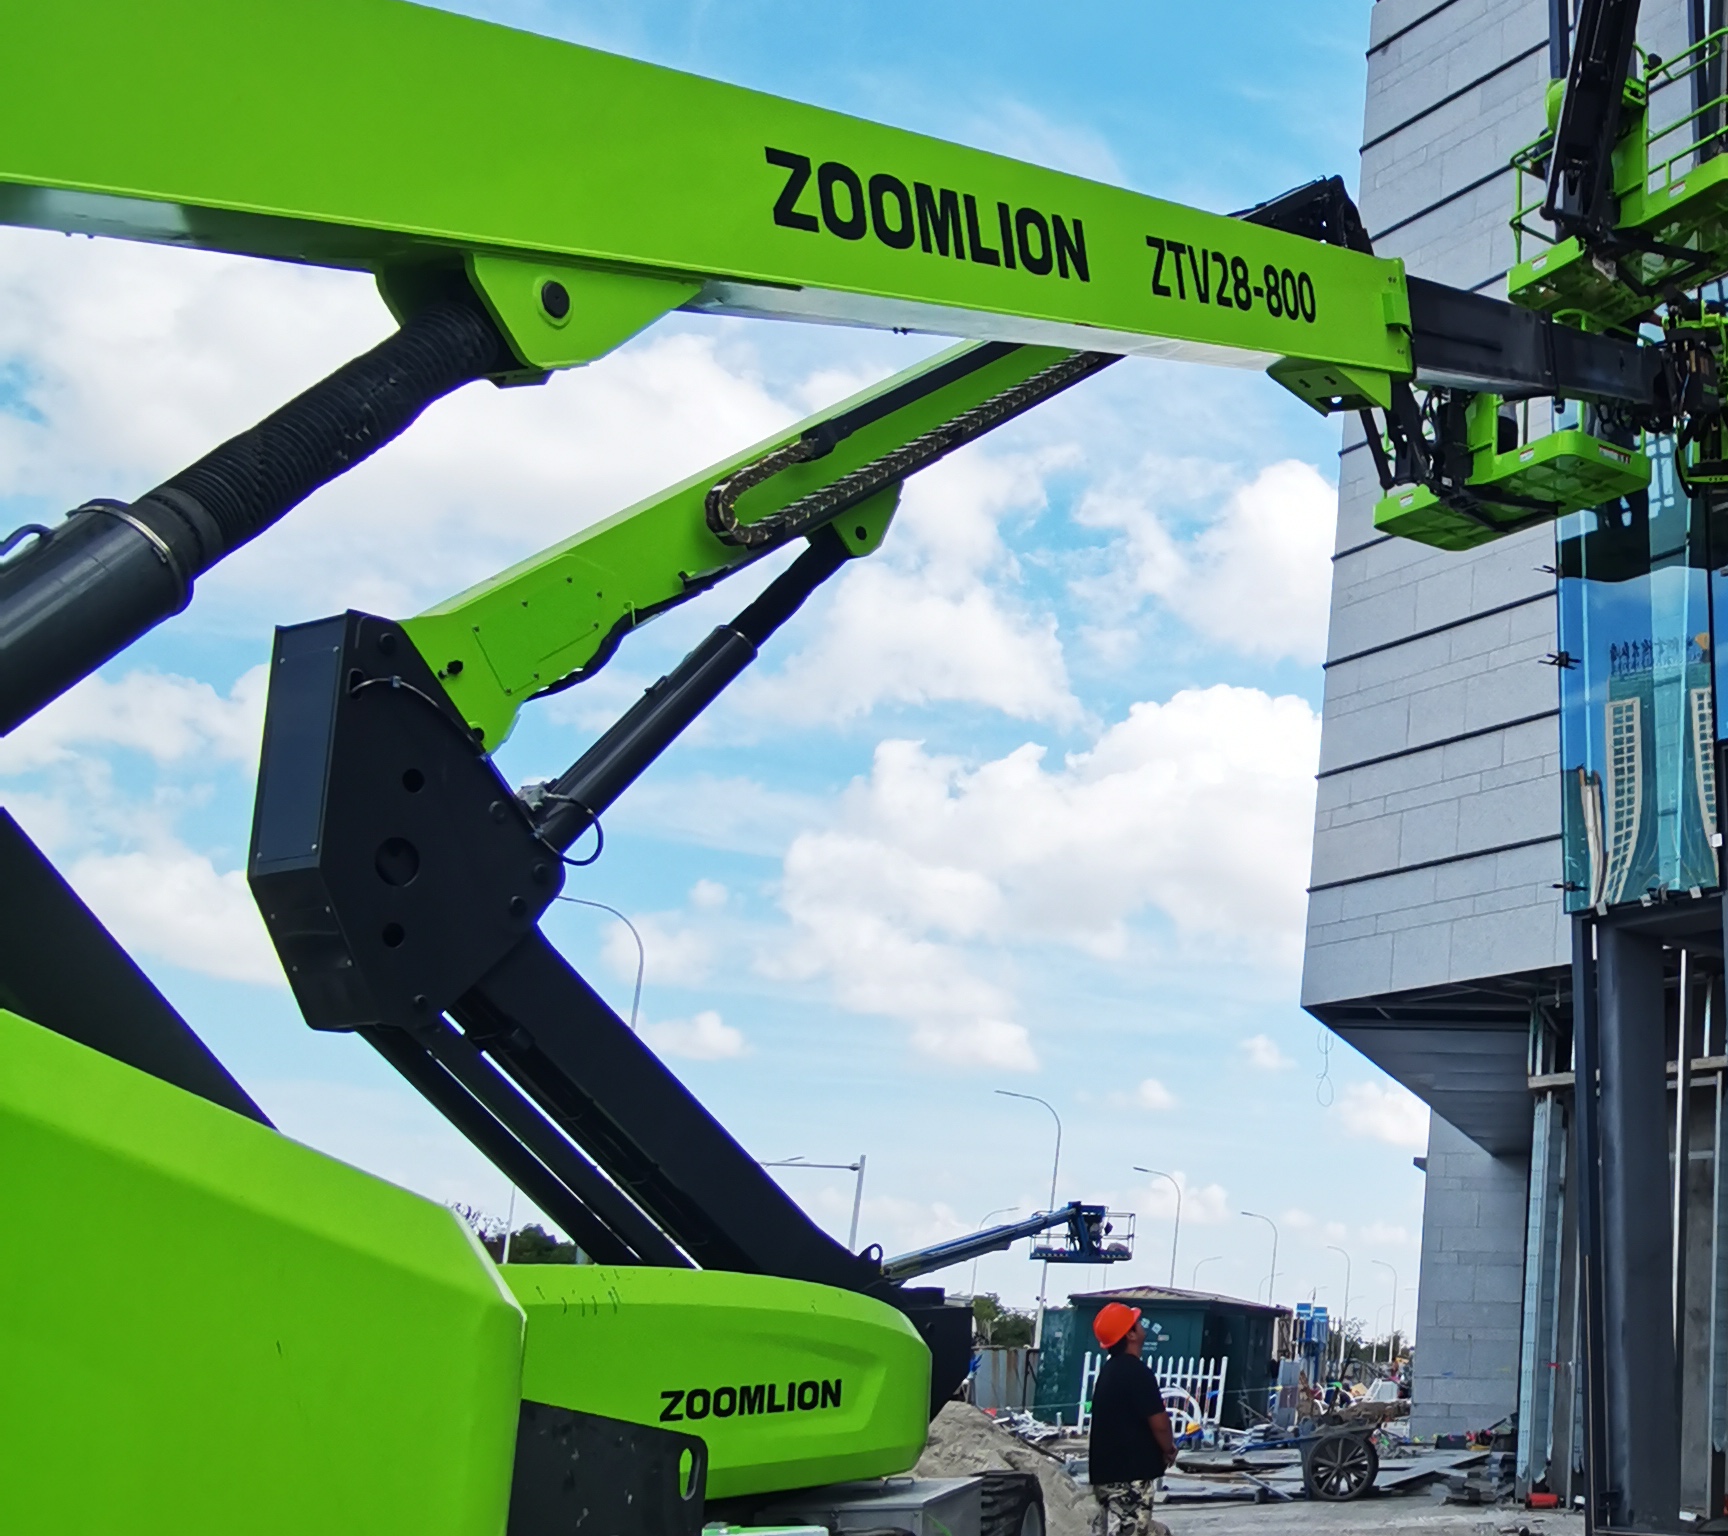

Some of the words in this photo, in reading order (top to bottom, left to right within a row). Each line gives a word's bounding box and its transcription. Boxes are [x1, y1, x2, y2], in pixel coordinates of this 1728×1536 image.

[765, 146, 1090, 283] ZOOMLION
[1145, 235, 1316, 324] ZTV28-800
[659, 1378, 842, 1422] ZOOMLION
